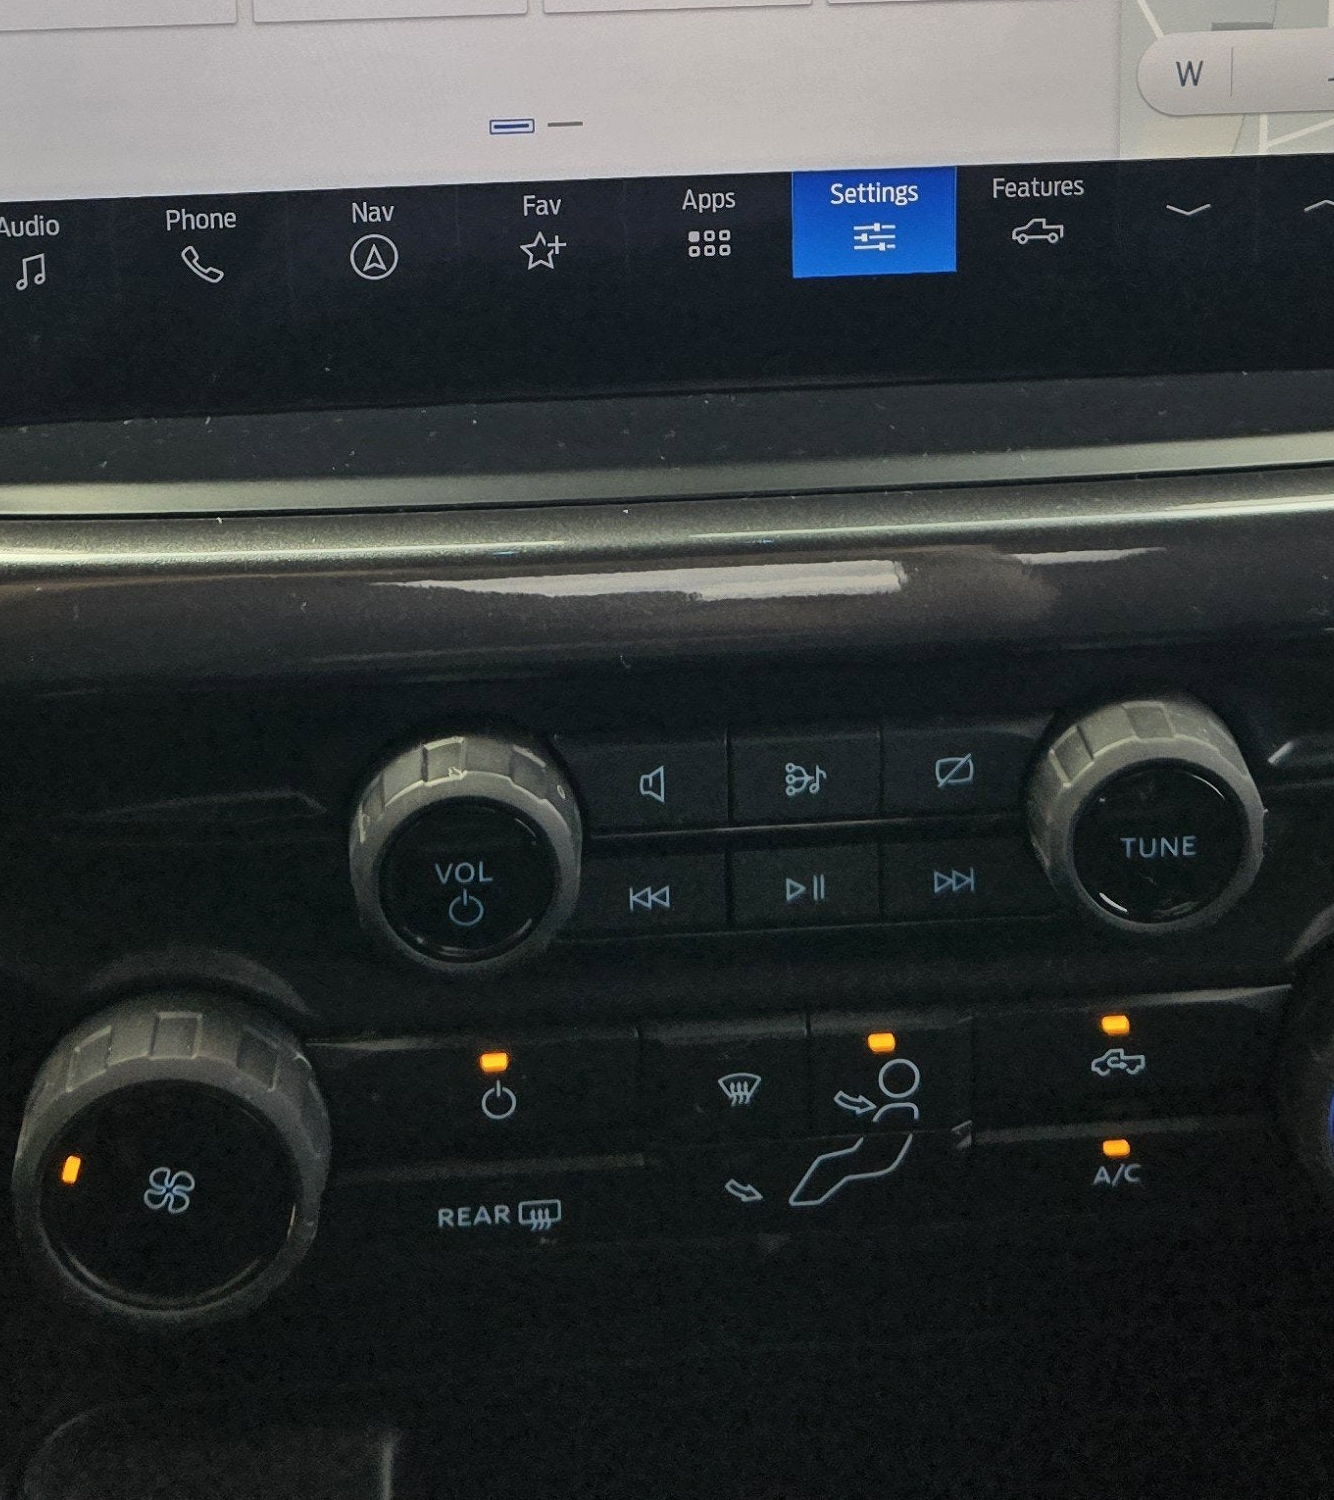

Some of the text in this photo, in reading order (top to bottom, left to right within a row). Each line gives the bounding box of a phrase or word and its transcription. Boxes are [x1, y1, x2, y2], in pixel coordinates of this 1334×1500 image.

[1175, 60, 1204, 87] W
[830, 182, 919, 207] Settings
[992, 177, 1085, 200] Features
[351, 201, 395, 224] Nav
[523, 194, 562, 217] Fav
[681, 188, 736, 214] Apps
[165, 208, 237, 232] Phone
[1120, 835, 1197, 859] TUNE
[435, 861, 493, 884] VOL
[1092, 1162, 1142, 1187] A/C
[437, 1204, 511, 1228] REAR
